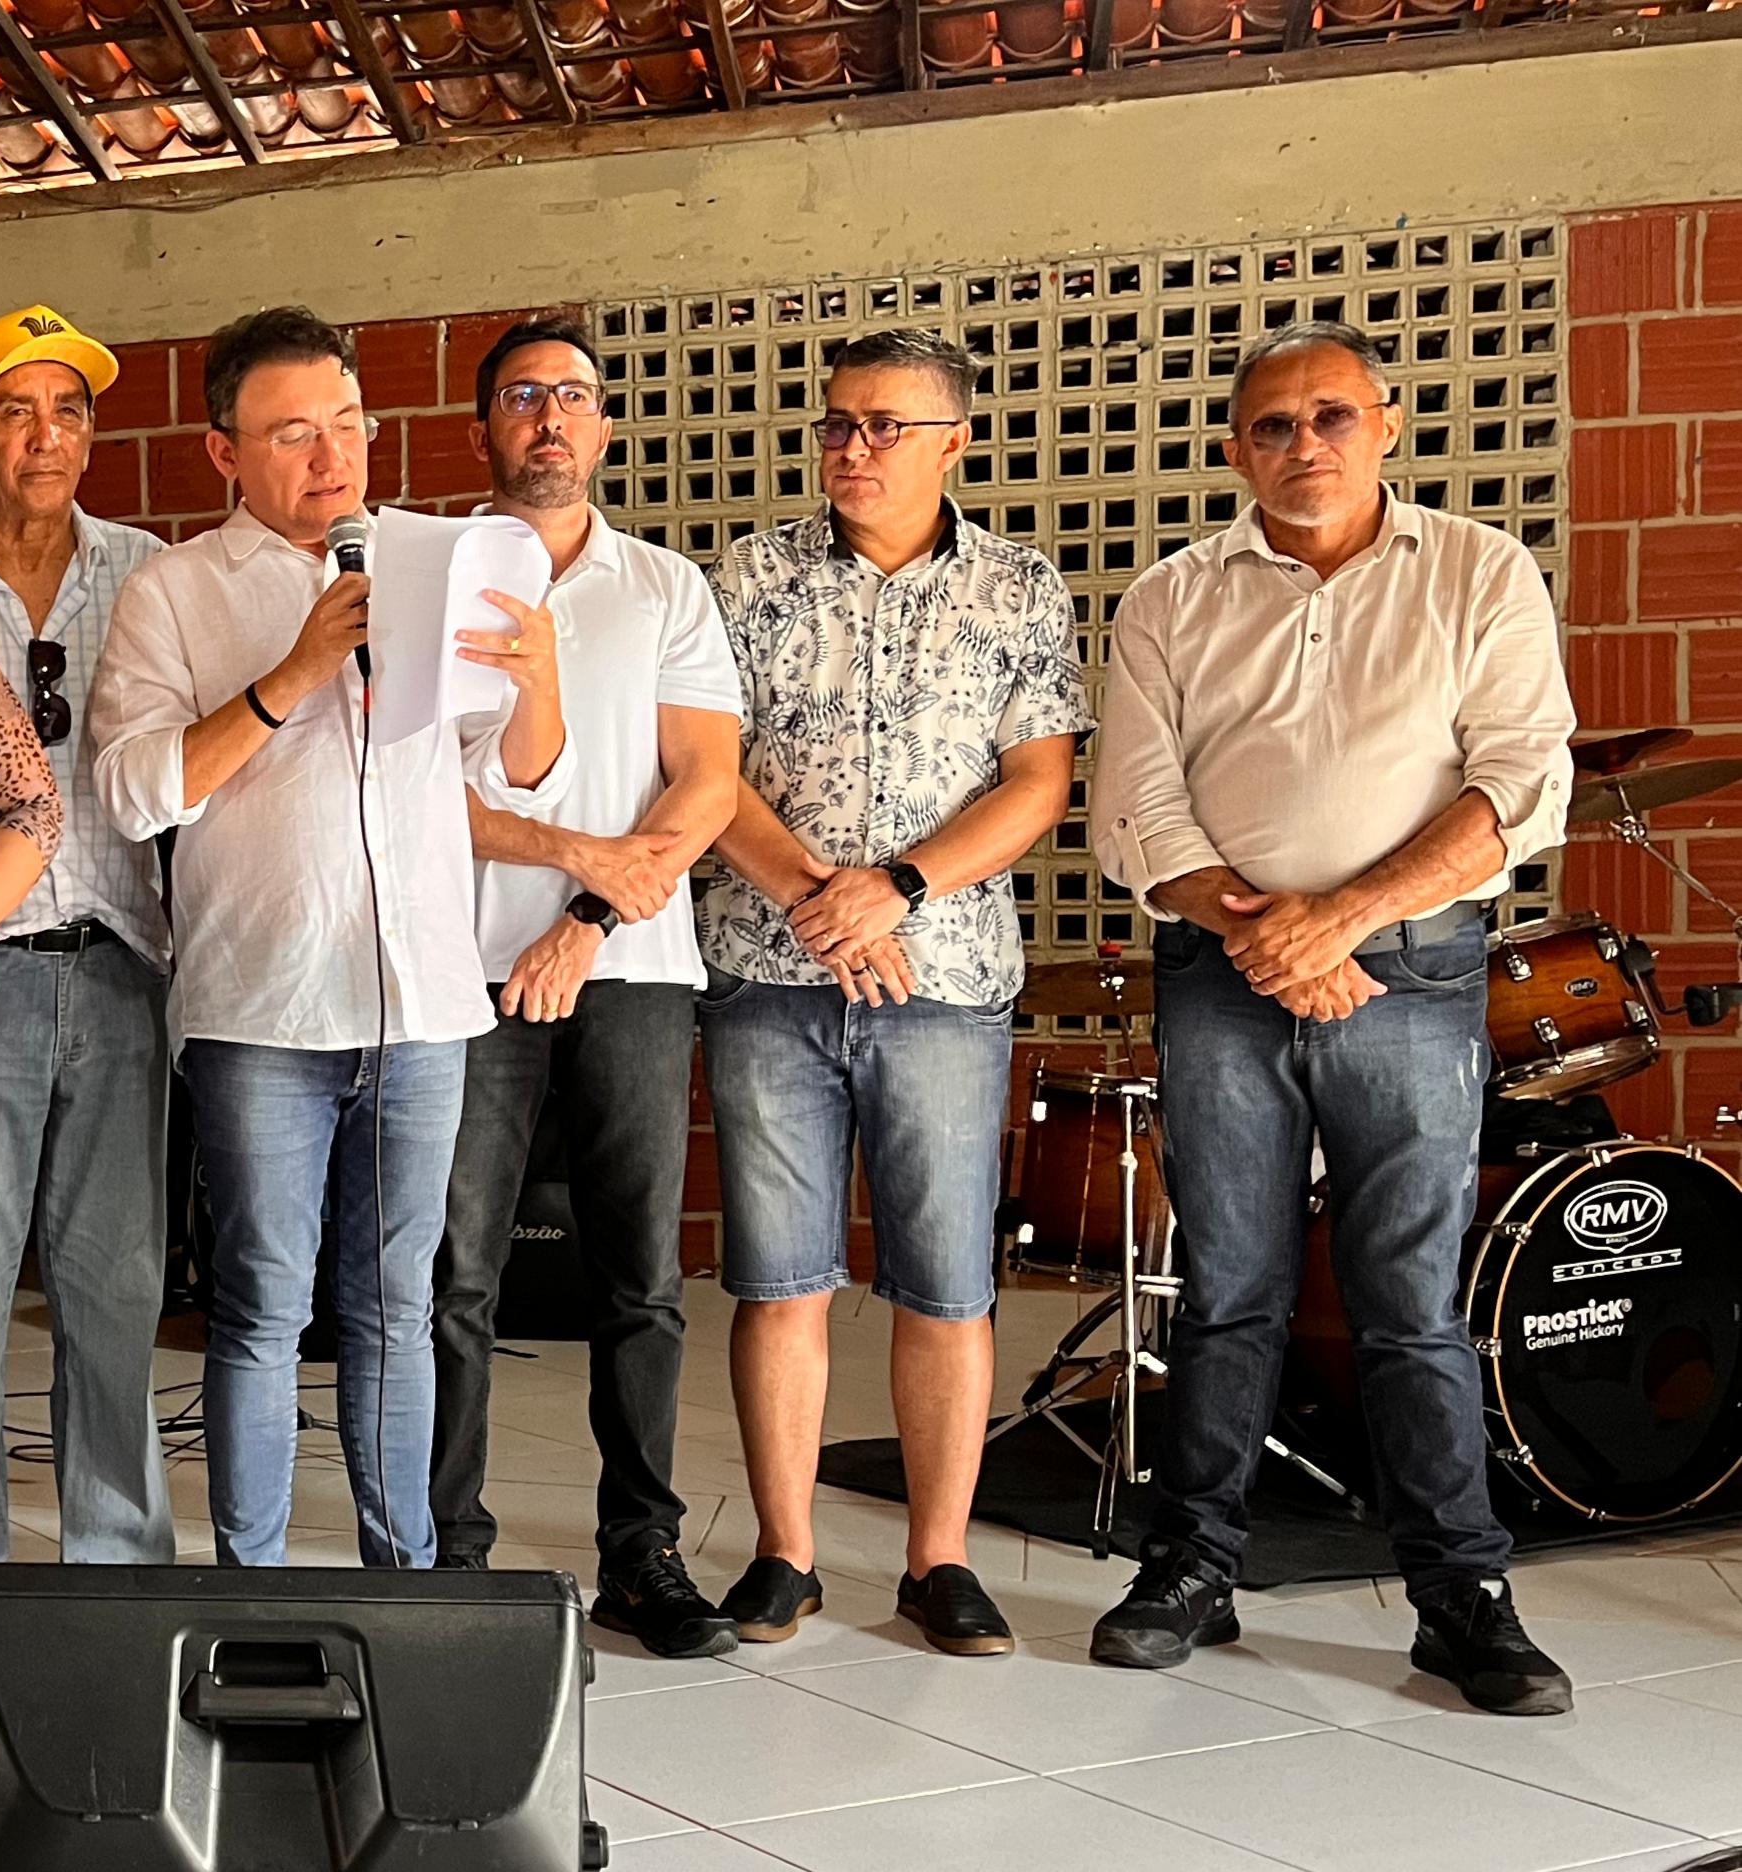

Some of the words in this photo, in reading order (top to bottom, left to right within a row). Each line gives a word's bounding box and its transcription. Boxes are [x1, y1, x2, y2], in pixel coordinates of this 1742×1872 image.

[1570, 979, 1594, 993] RMV
[1580, 1197, 1652, 1229] RMV
[1525, 1331, 1577, 1351] Genuine
[1578, 1323, 1625, 1341] Hickory
